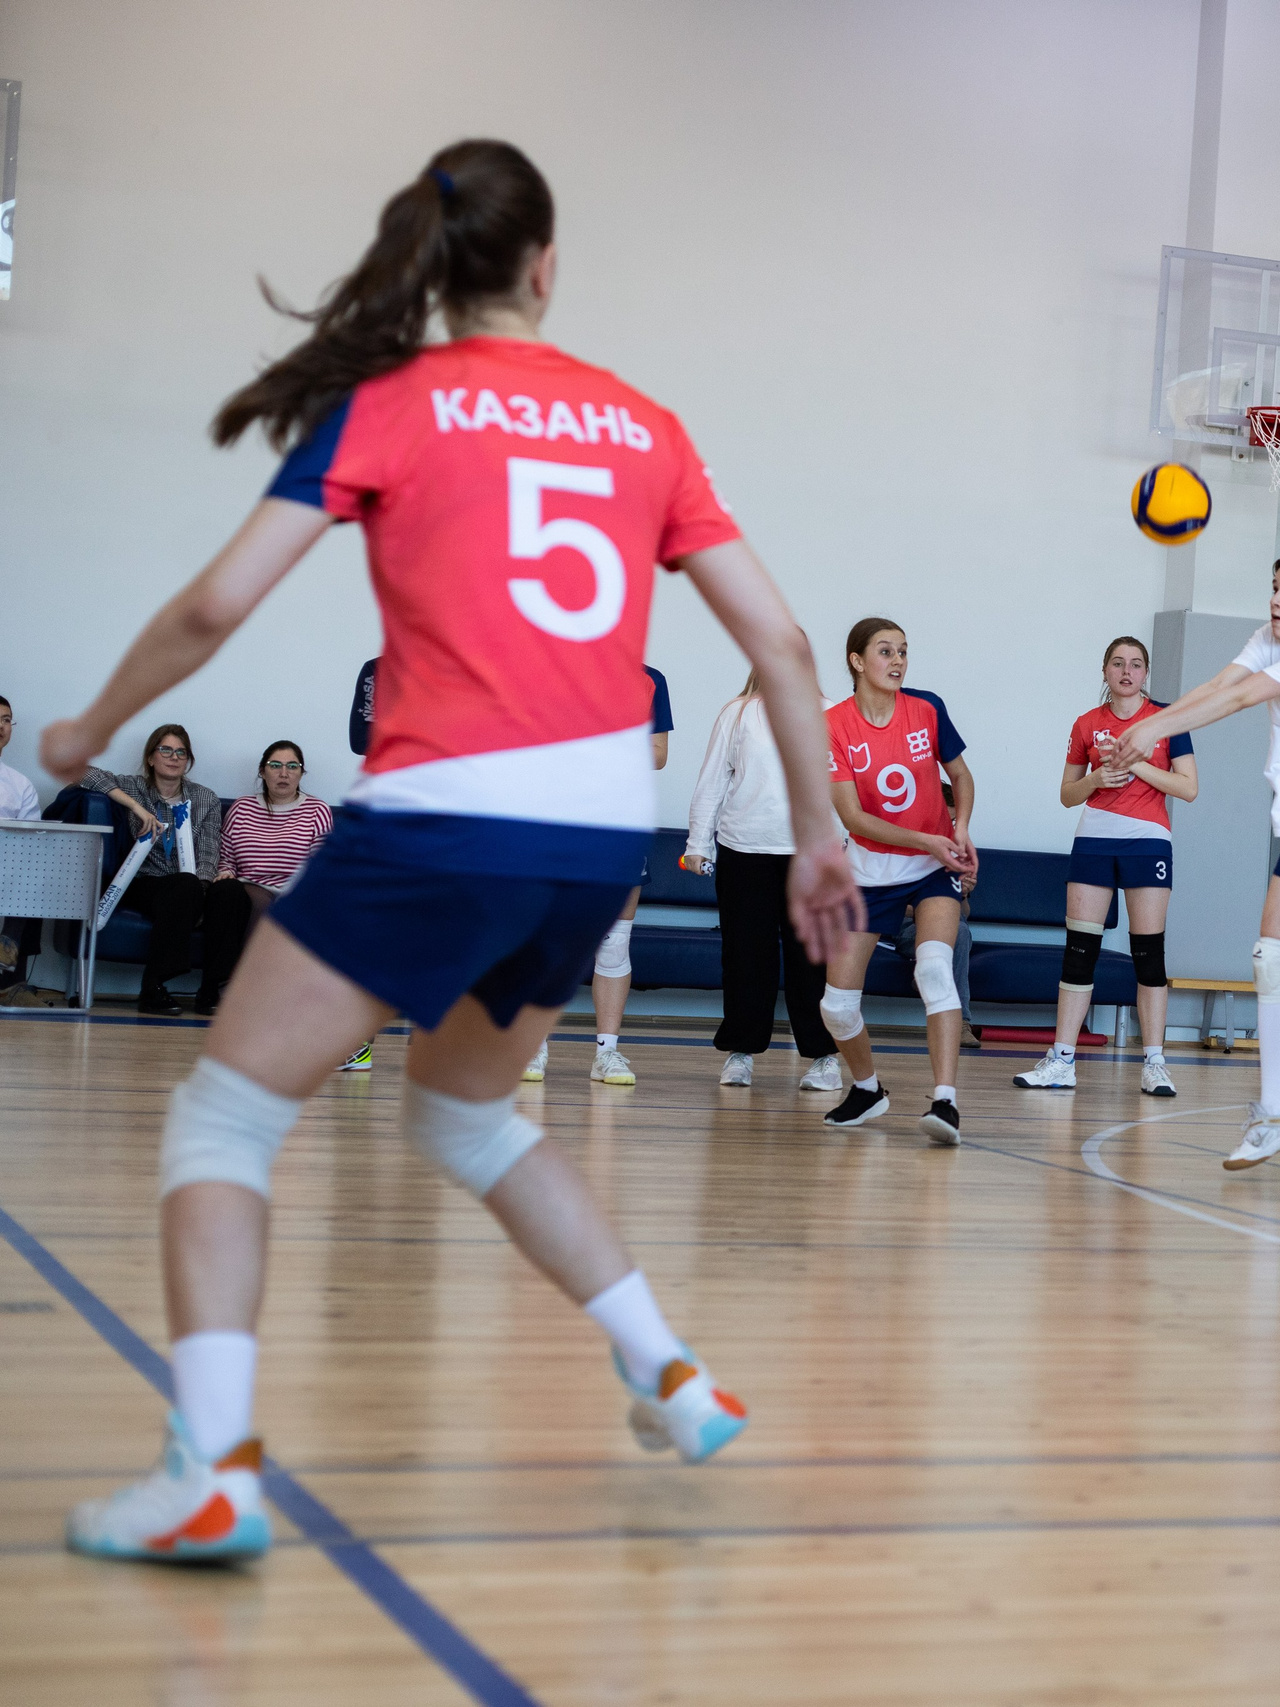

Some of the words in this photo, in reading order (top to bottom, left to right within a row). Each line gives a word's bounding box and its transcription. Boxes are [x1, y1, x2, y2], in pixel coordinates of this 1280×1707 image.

[431, 387, 653, 453] КАЗАНЬ
[506, 456, 627, 642] 5
[876, 763, 917, 813] 9
[1155, 860, 1167, 880] 3
[101, 898, 115, 918] RUSSIA
[111, 887, 122, 901] 2015
